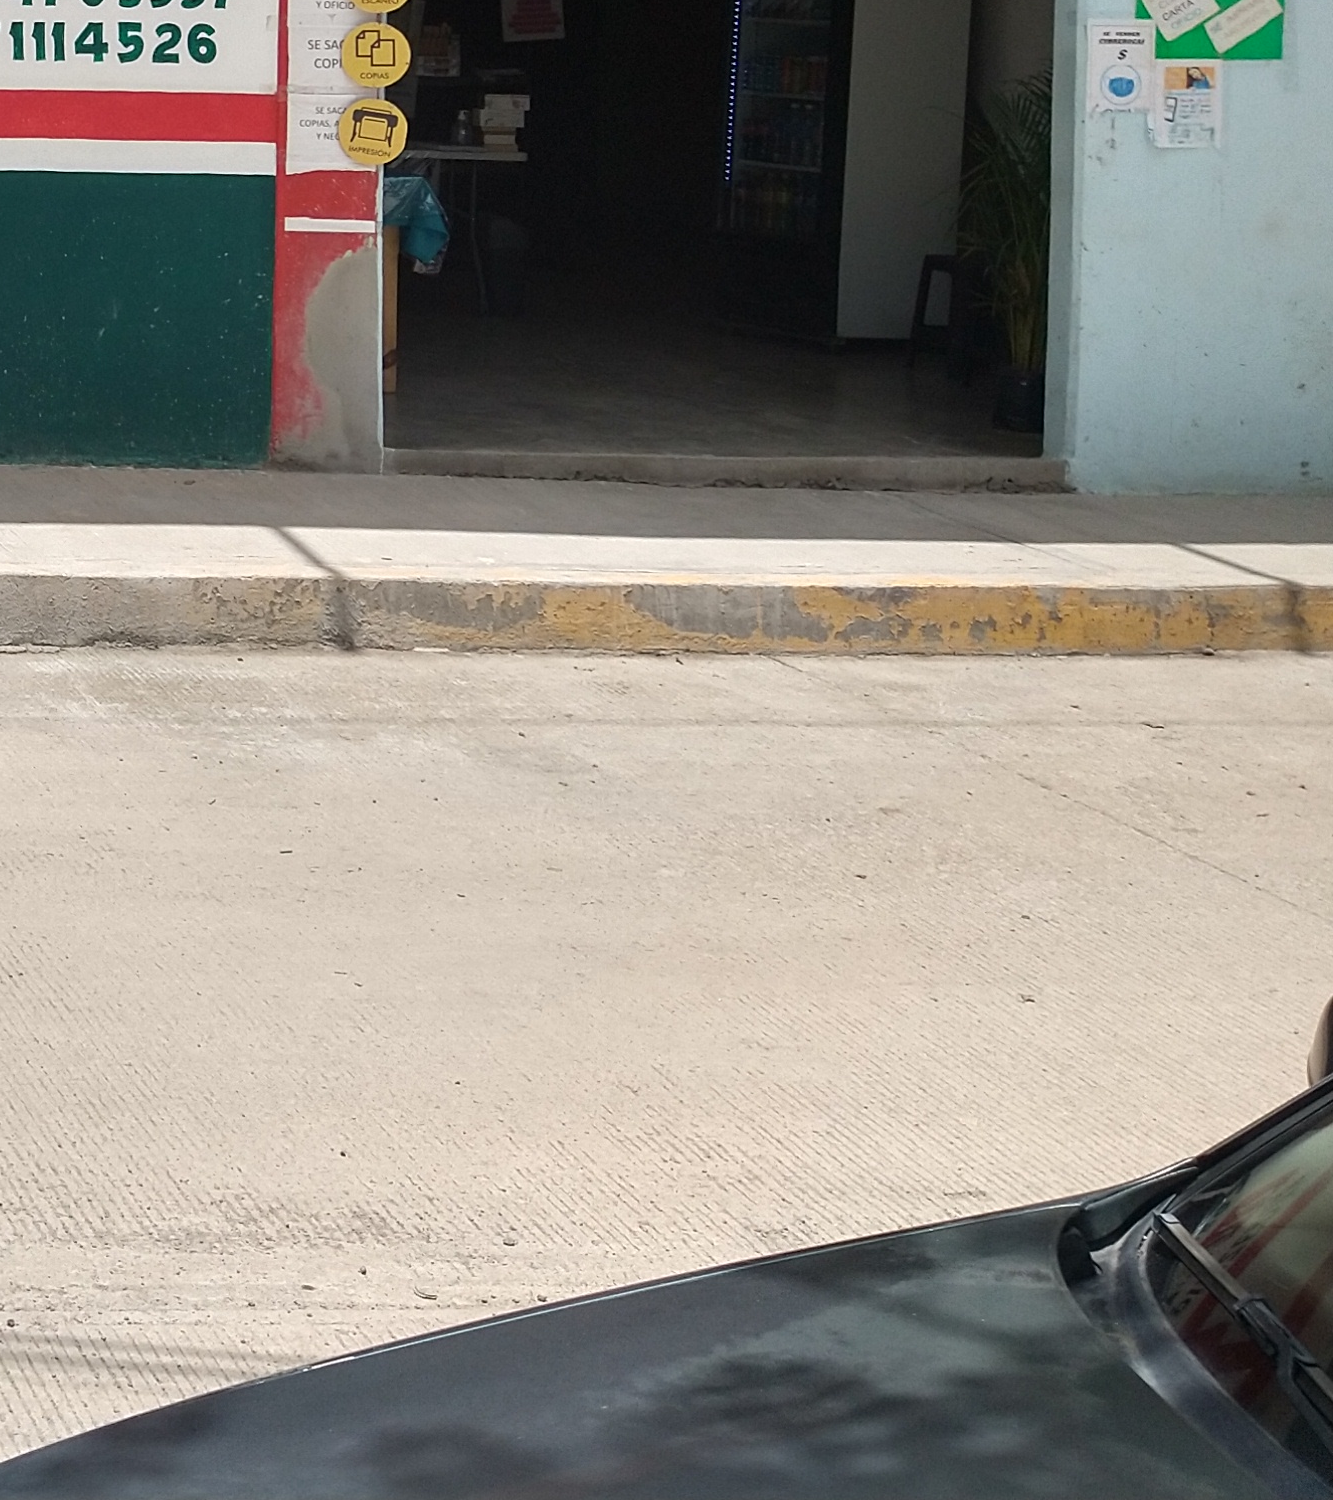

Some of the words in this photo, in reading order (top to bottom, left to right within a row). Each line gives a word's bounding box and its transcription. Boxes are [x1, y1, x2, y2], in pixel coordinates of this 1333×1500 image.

[316, 1, 321, 9] Y
[324, 1, 355, 10] OFICIO
[1162, 0, 1195, 21] CARTA
[307, 40, 321, 50] SE
[314, 58, 343, 69] COPI
[359, 72, 389, 80] COPIAS
[315, 107, 326, 115] SE
[327, 107, 347, 115] SACA
